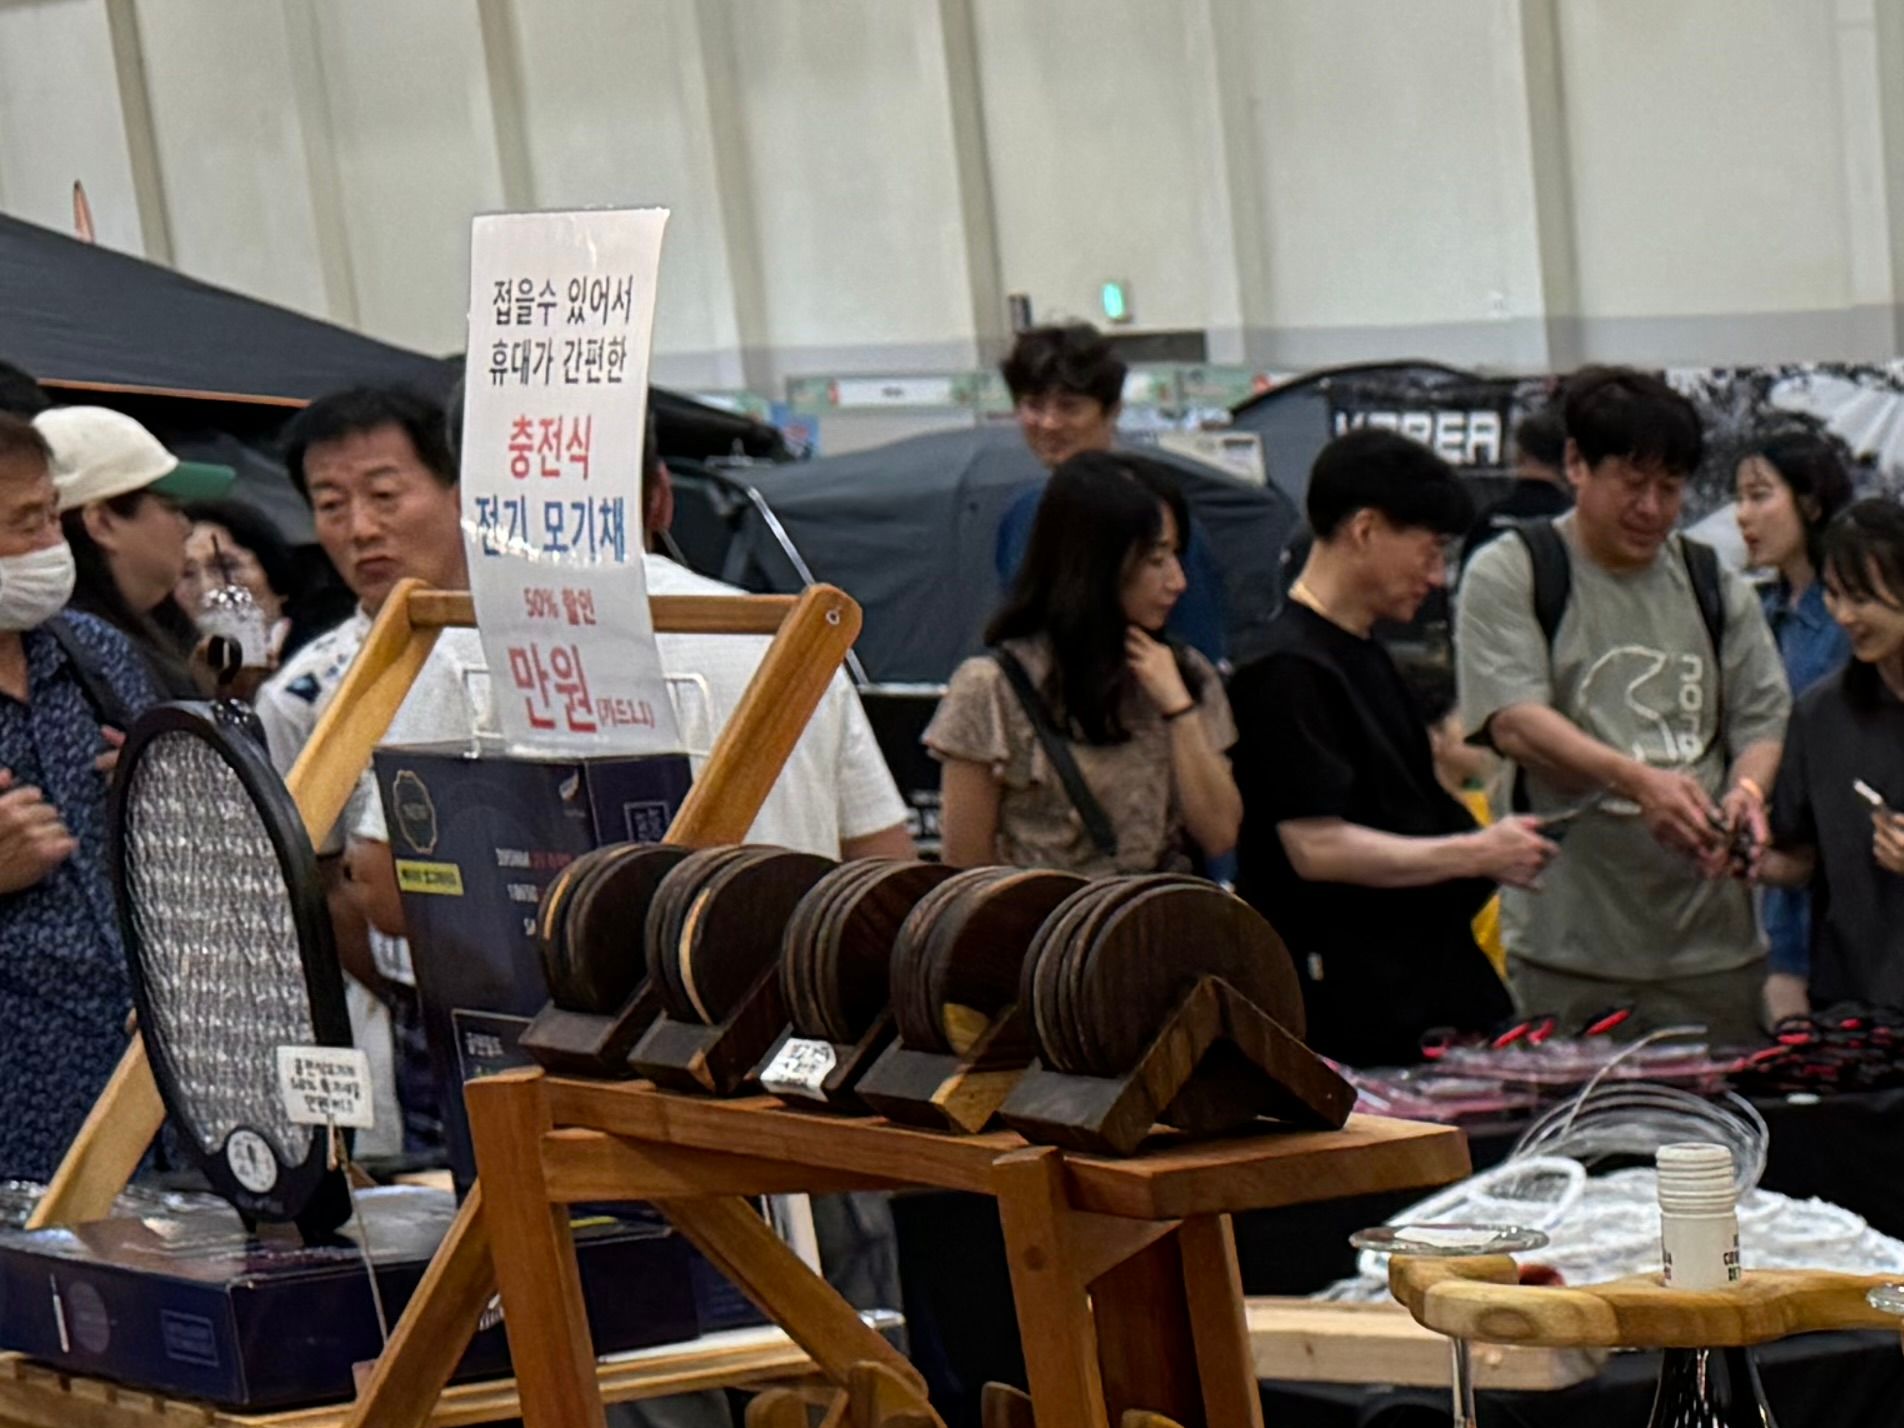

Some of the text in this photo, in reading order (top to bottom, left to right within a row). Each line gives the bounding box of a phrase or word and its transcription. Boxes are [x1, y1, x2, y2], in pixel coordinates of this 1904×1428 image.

[493, 275, 634, 326] 접을수 있어서
[489, 336, 627, 386] 휴대가 간편한
[508, 414, 592, 479] 충전식
[543, 495, 625, 562] 모기채
[508, 643, 597, 733] 만원
